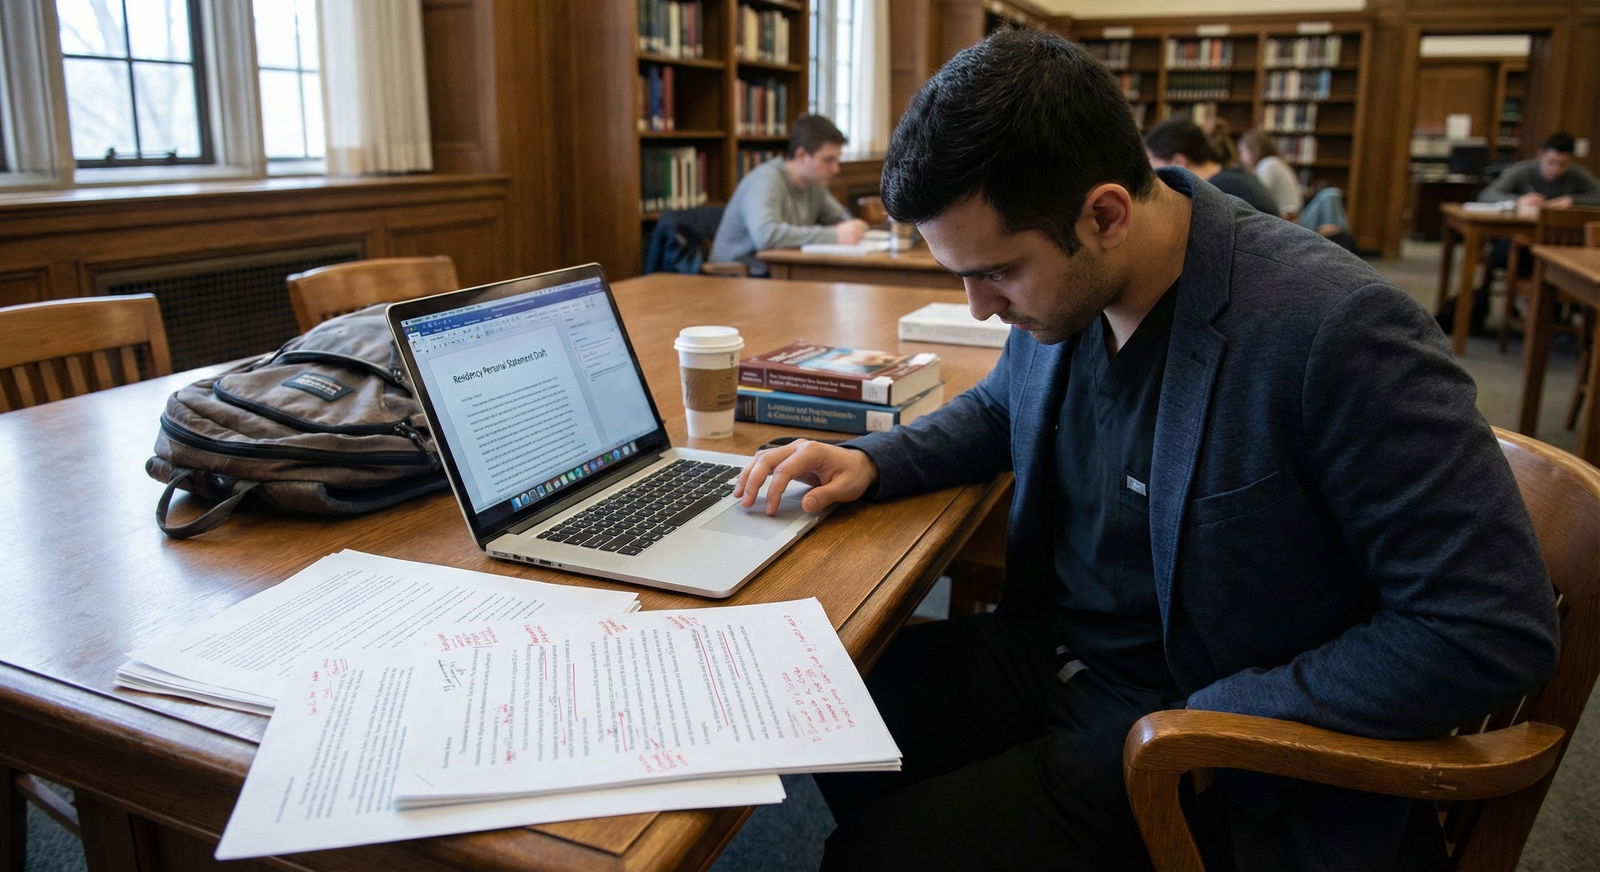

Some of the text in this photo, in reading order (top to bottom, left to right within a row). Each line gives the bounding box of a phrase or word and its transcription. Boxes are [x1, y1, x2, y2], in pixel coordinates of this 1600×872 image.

[453, 348, 547, 384] Residency Personal Statement Draft
